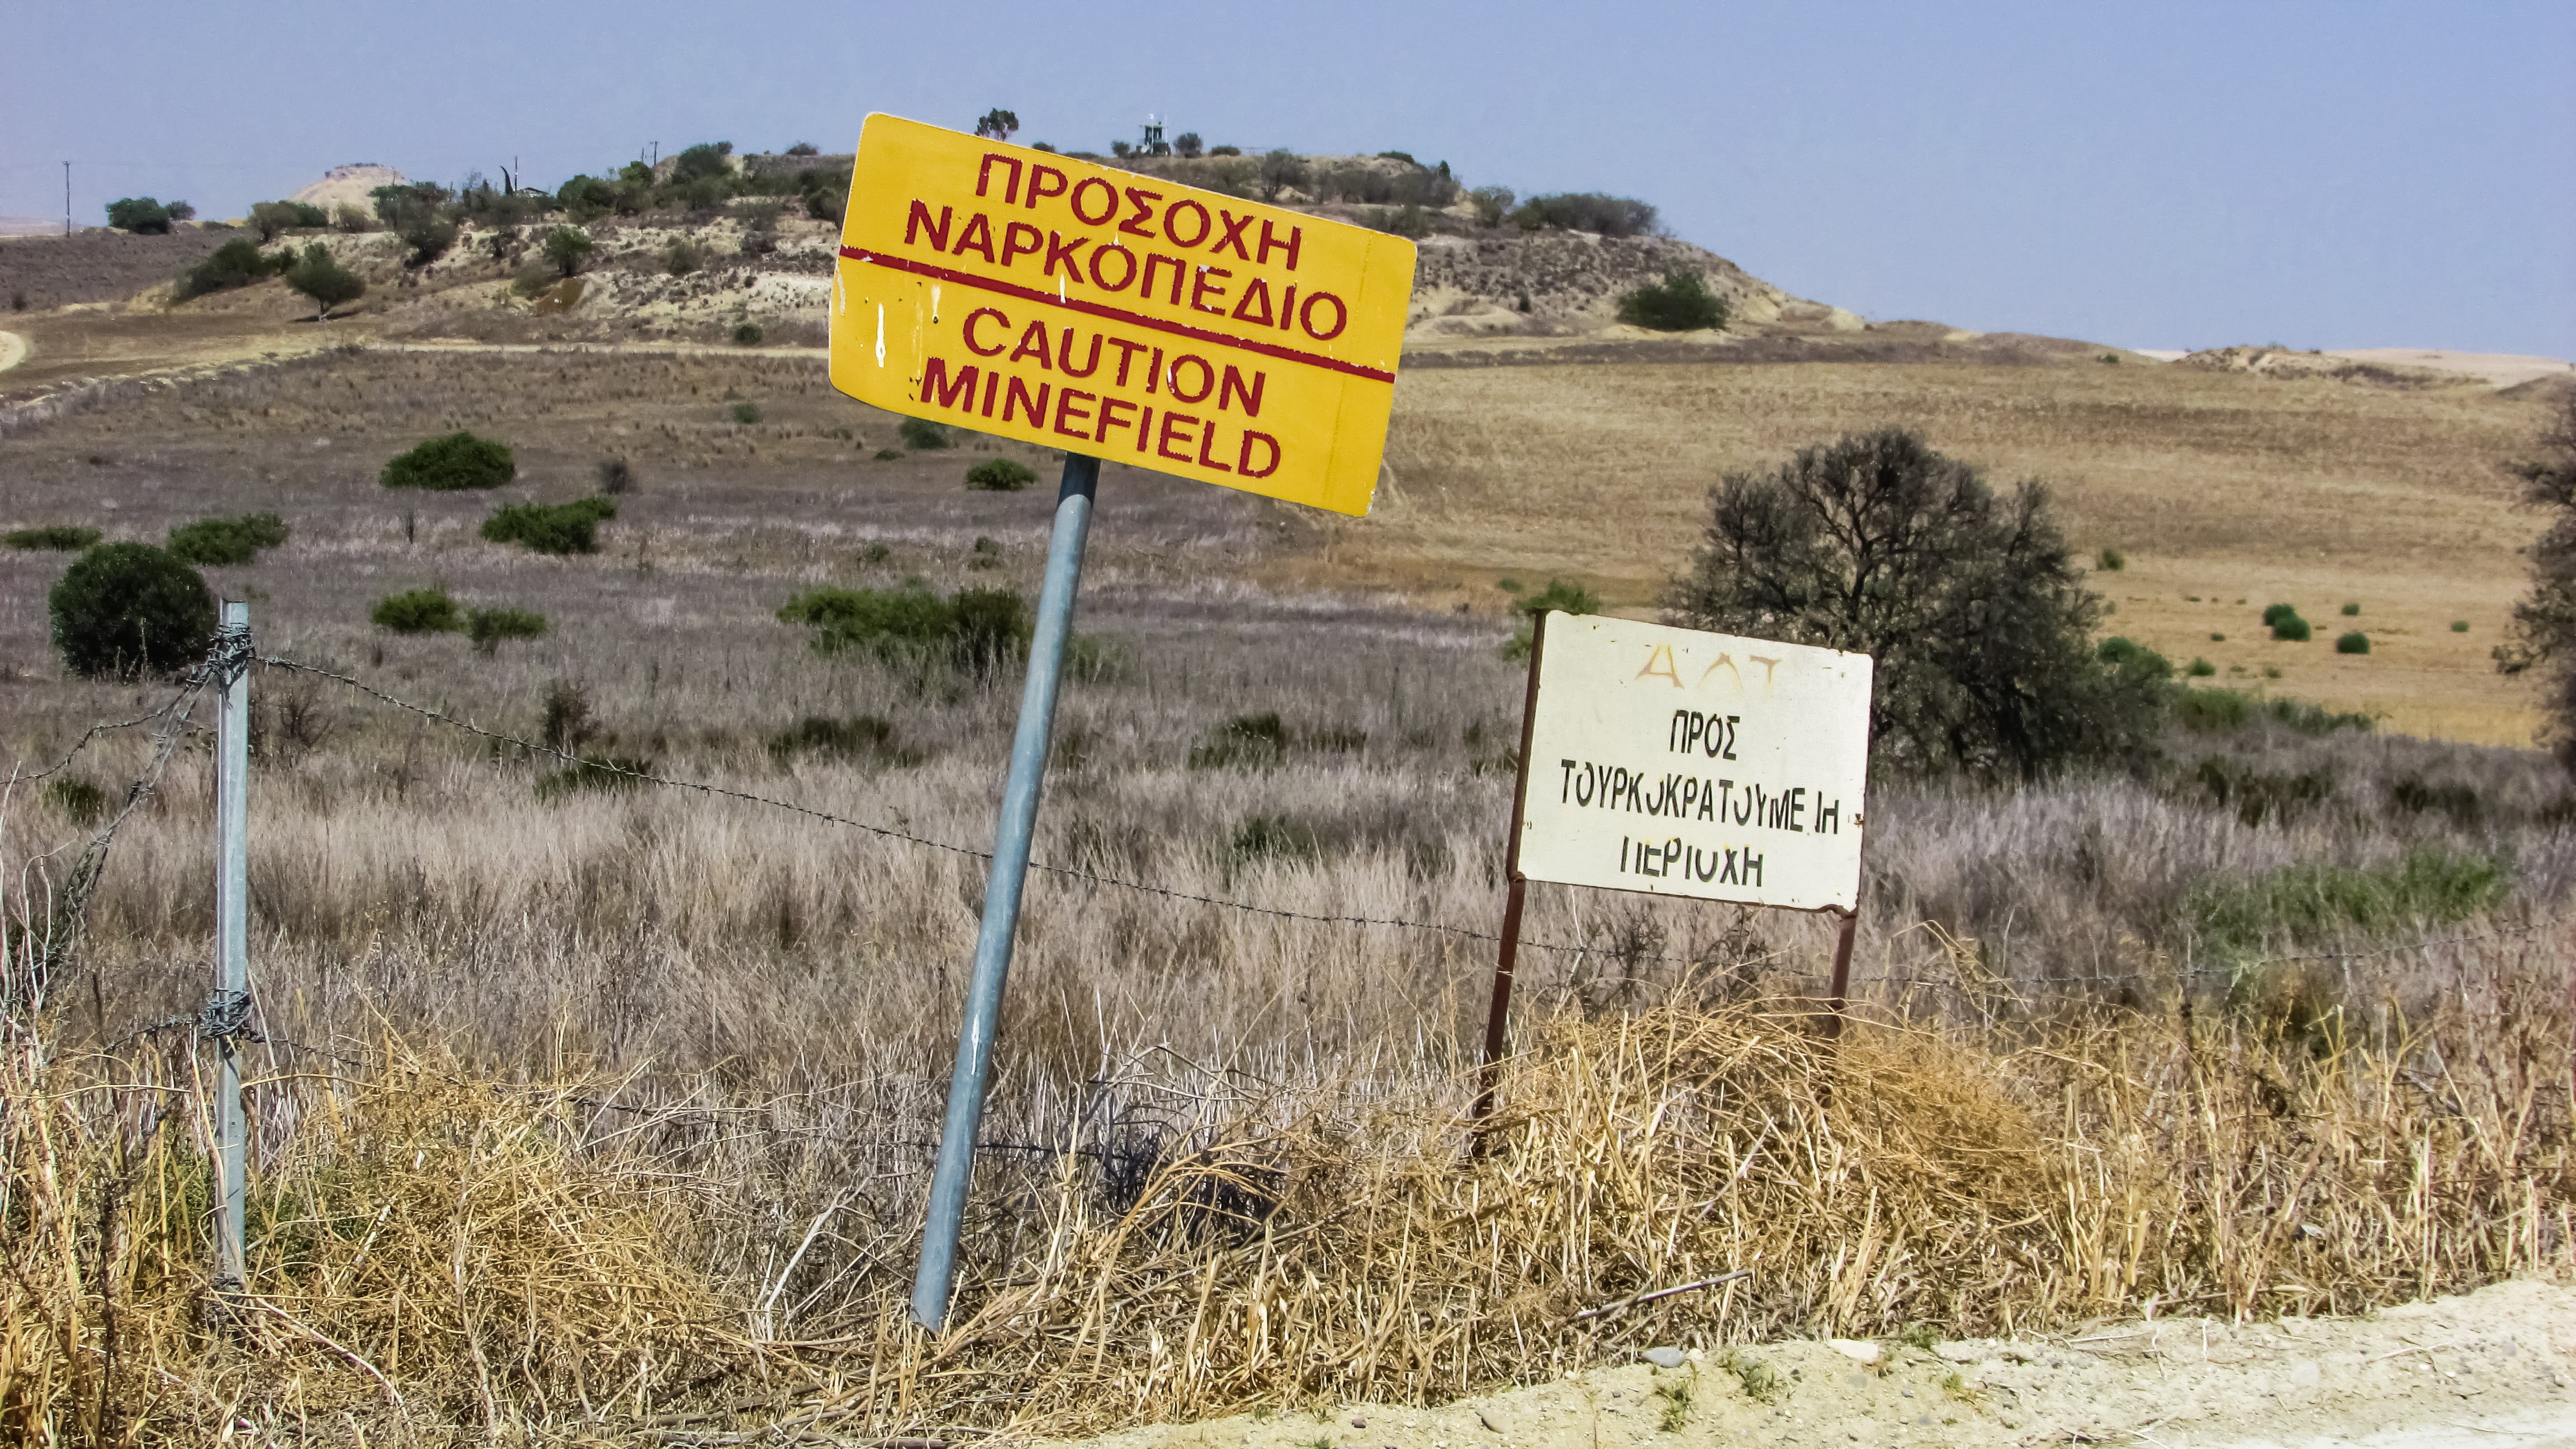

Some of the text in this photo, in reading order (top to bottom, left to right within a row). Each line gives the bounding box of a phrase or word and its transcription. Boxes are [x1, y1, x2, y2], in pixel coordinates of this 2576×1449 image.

[905, 199, 1347, 341] ΝΑΡΚΟΠΕΔΙΟ
[976, 153, 1301, 271] ΠΡΟΣΟΧΗ
[920, 357, 1281, 479] MINEFIELD
[963, 307, 1266, 418] CAUTION
[1669, 709, 1741, 761] ΠΡΟΣ
